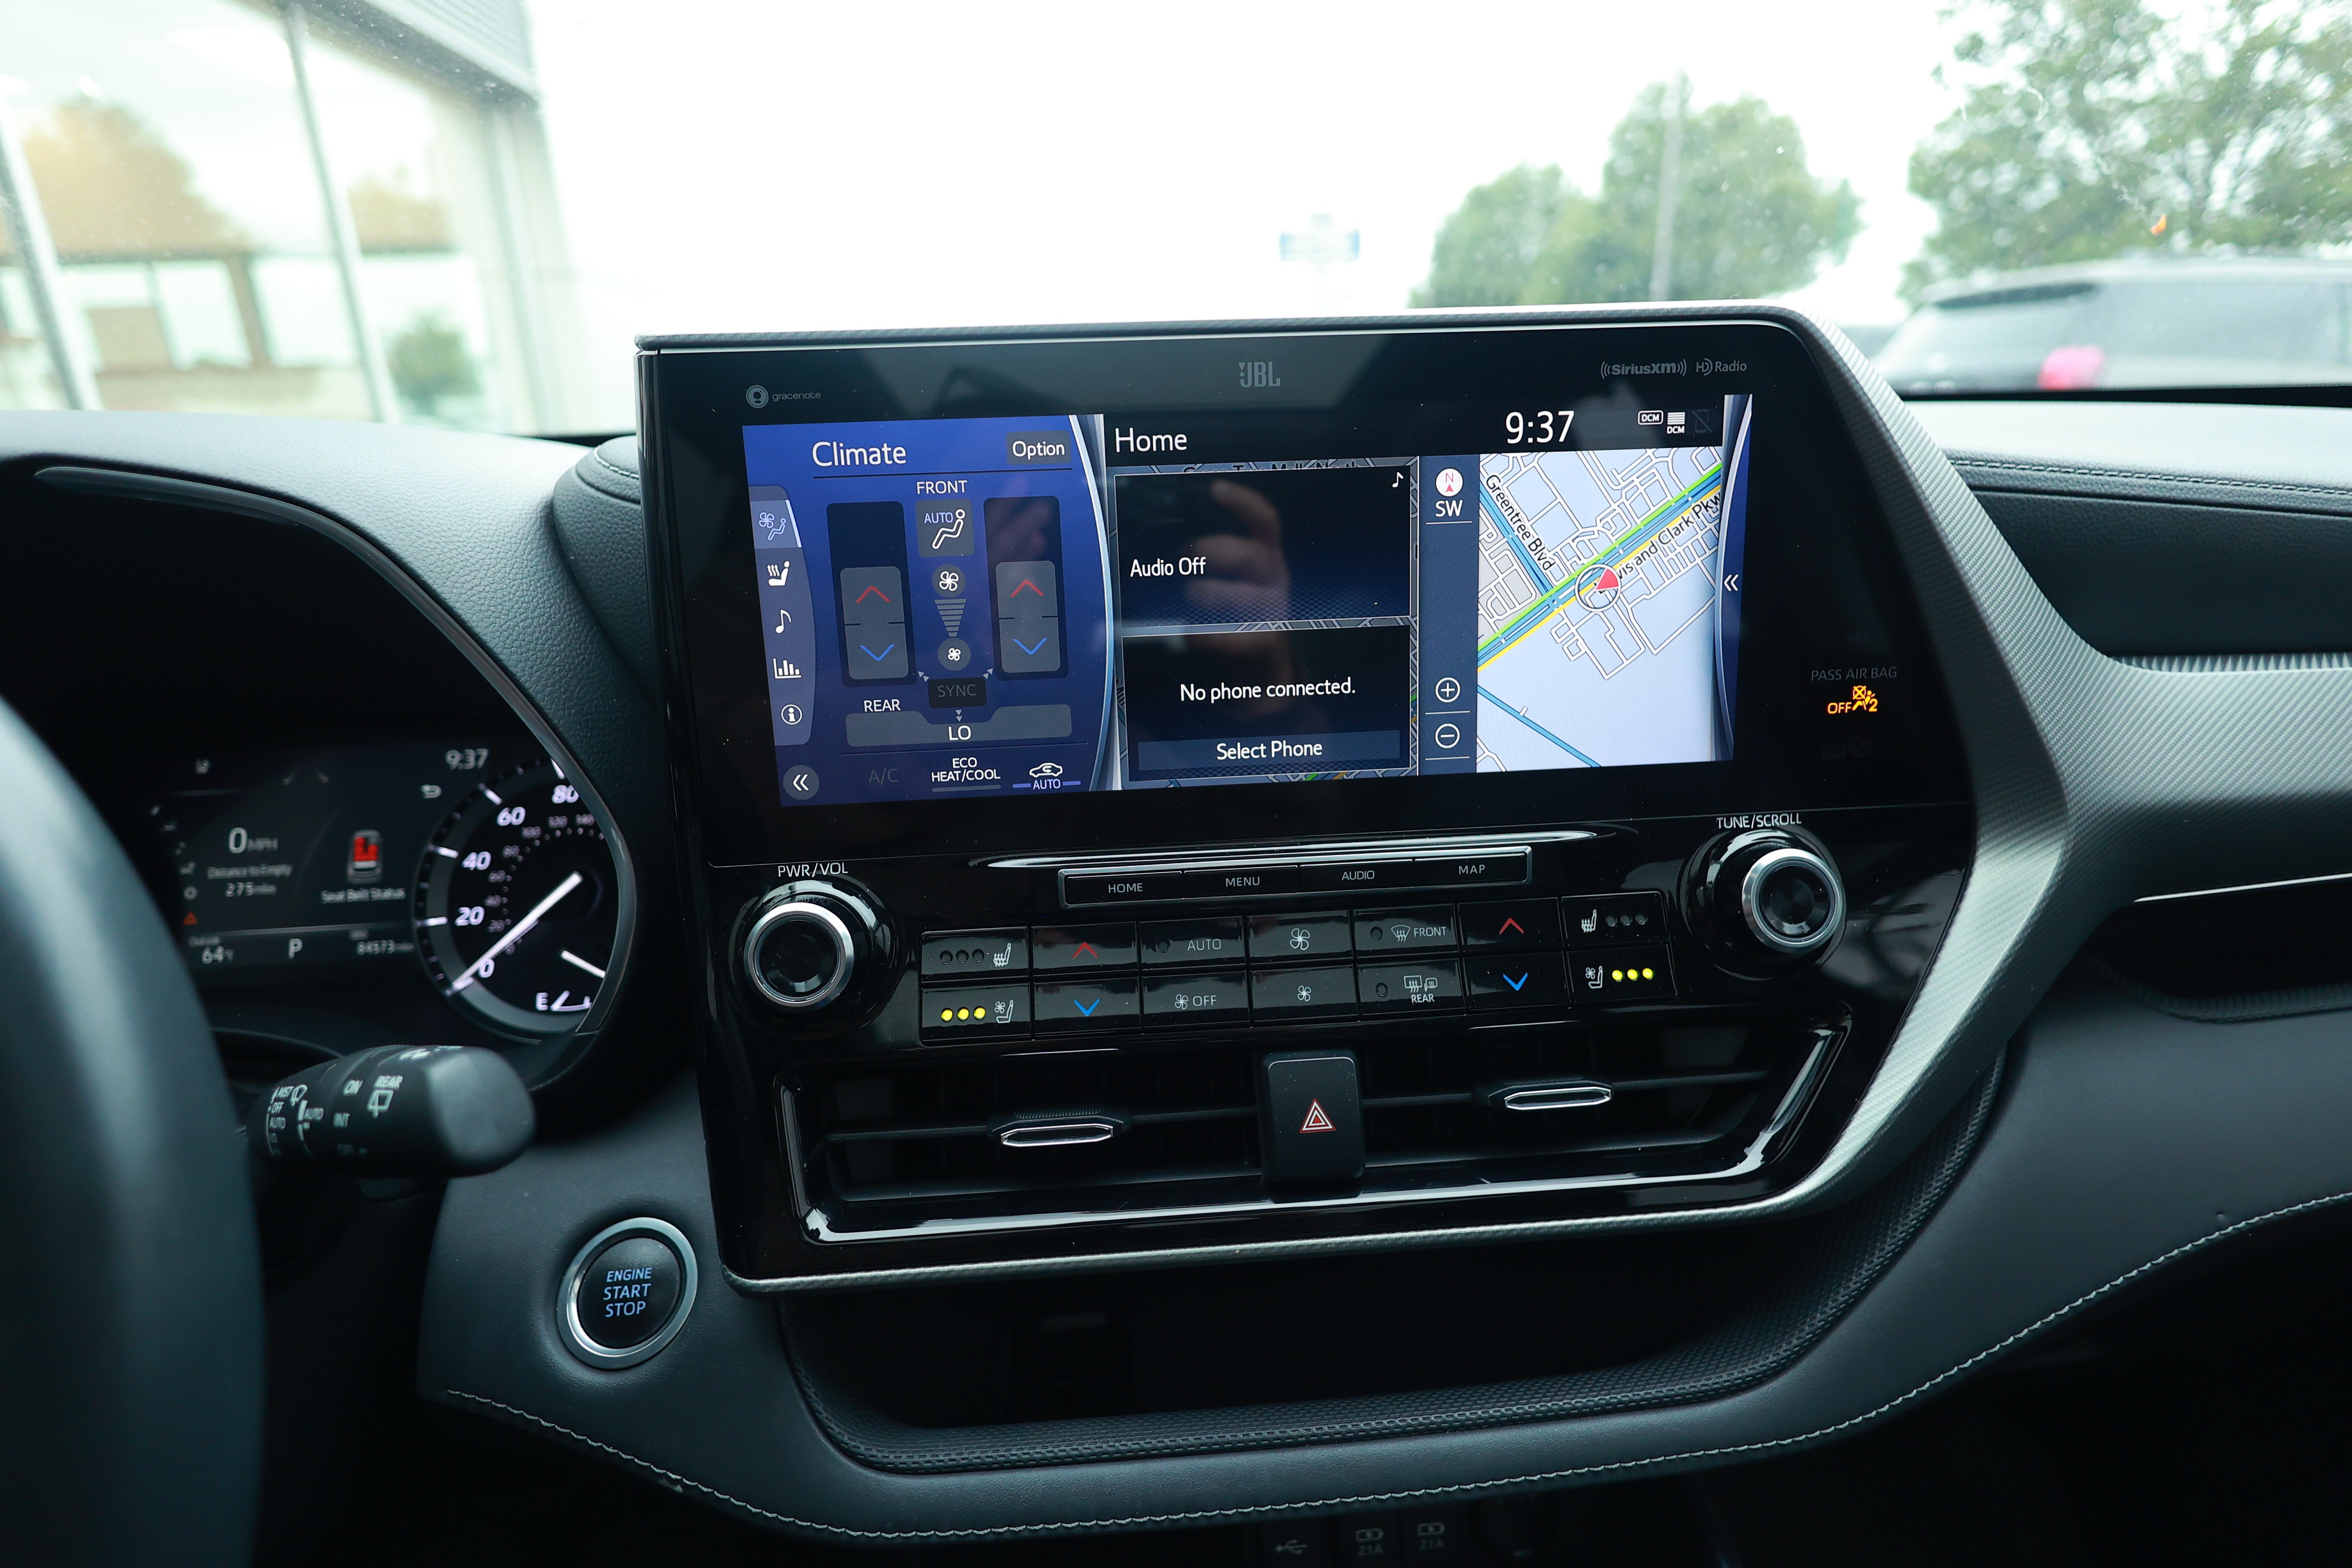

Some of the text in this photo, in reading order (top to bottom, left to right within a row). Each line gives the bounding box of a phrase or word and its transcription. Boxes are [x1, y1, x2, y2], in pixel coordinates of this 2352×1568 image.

[1715, 360, 1747, 372] Radio
[1239, 361, 1281, 388] JBL
[772, 391, 821, 402] gracenote
[1641, 413, 1660, 423] DCM
[1506, 410, 1574, 444] 9:37
[1666, 425, 1685, 434] DCM
[1115, 427, 1187, 453] Home
[812, 441, 907, 467] Climate
[1012, 441, 1065, 460] Option
[1445, 472, 1454, 483] N
[916, 480, 968, 495] FRONT
[1435, 500, 1463, 518] SW
[924, 512, 953, 524] AUTO
[1486, 475, 1556, 571] Greentree Blvd
[1634, 540, 1658, 566] and
[1658, 516, 1694, 545] Clark
[1130, 556, 1206, 577] Audio Off
[1811, 666, 1897, 681] PASS AIR BAG
[937, 684, 977, 698] SYNC
[1180, 677, 1356, 704] No phone connected.
[864, 699, 901, 712] REAR
[1827, 702, 1852, 714] OFF
[949, 725, 971, 741] LO
[1216, 740, 1323, 760] Select Phone
[445, 748, 488, 770] 9:37
[952, 757, 977, 769] ECO
[869, 767, 899, 785] A/C
[931, 769, 1001, 783] HEAT/COOL
[1033, 778, 1061, 790] AUTO
[552, 785, 579, 803] 80
[497, 806, 526, 826] 60
[1717, 813, 1801, 829] TUNE/SCROLL
[229, 827, 247, 854] 0
[462, 851, 491, 870] 40
[778, 862, 848, 878] PWR/VOL
[1341, 870, 1375, 881] AUDIO
[1458, 864, 1485, 875] MAP
[1108, 882, 1143, 893] HOME
[1225, 876, 1260, 888] MENU
[455, 906, 484, 926] 20
[1414, 926, 1446, 937] FRONT
[288, 938, 303, 959] P
[1188, 938, 1221, 951] AUTO
[478, 959, 495, 978] 0
[536, 992, 549, 1011] E
[1193, 995, 1217, 1007] OFF
[1411, 993, 1435, 1003] REAR
[344, 1080, 363, 1095] ON
[375, 1075, 404, 1089] REAR
[304, 1108, 324, 1121] AUTO
[270, 1117, 286, 1129] AUTO
[606, 1268, 652, 1282] ENGINE
[603, 1283, 652, 1300] START
[605, 1301, 646, 1317] STOP
